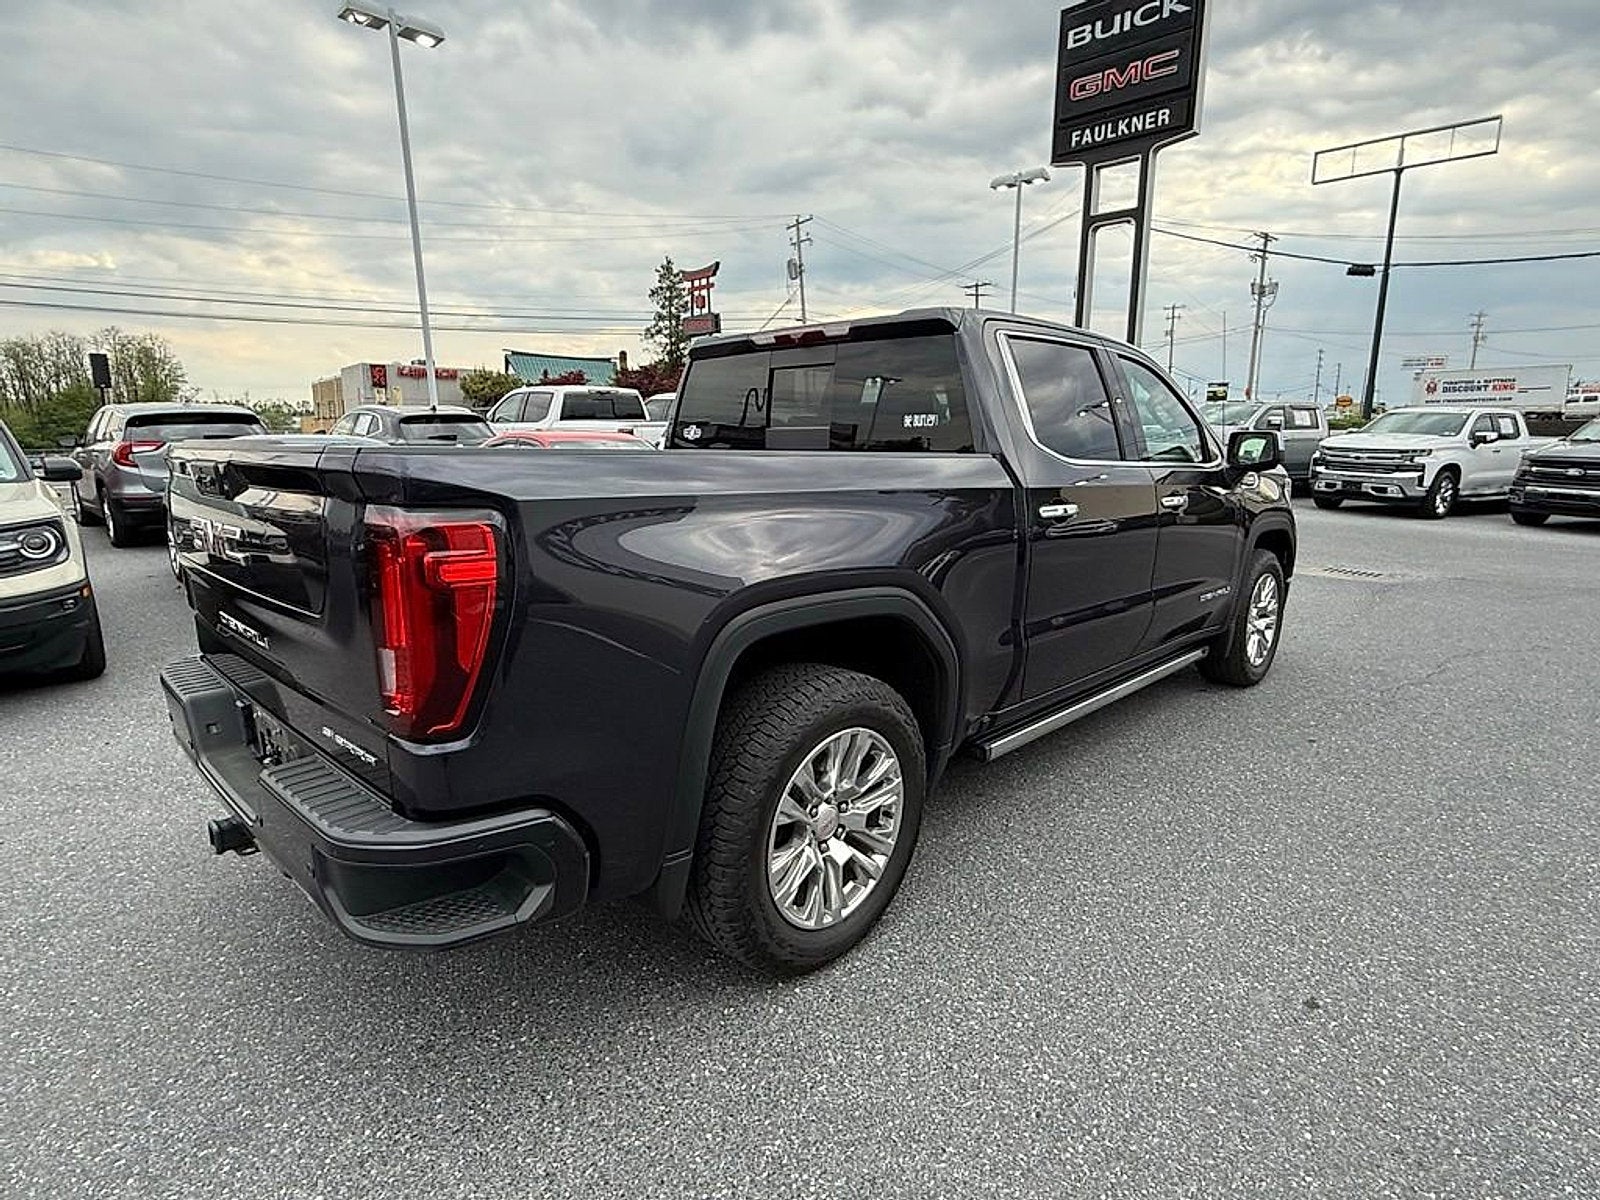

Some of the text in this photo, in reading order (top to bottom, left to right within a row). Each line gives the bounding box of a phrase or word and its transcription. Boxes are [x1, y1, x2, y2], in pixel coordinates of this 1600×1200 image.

[1066, 0, 1191, 49] BUICK
[1070, 50, 1179, 100] GMC
[1071, 108, 1170, 147] FAULKNER
[1442, 383, 1516, 393] DISCOUNT KING
